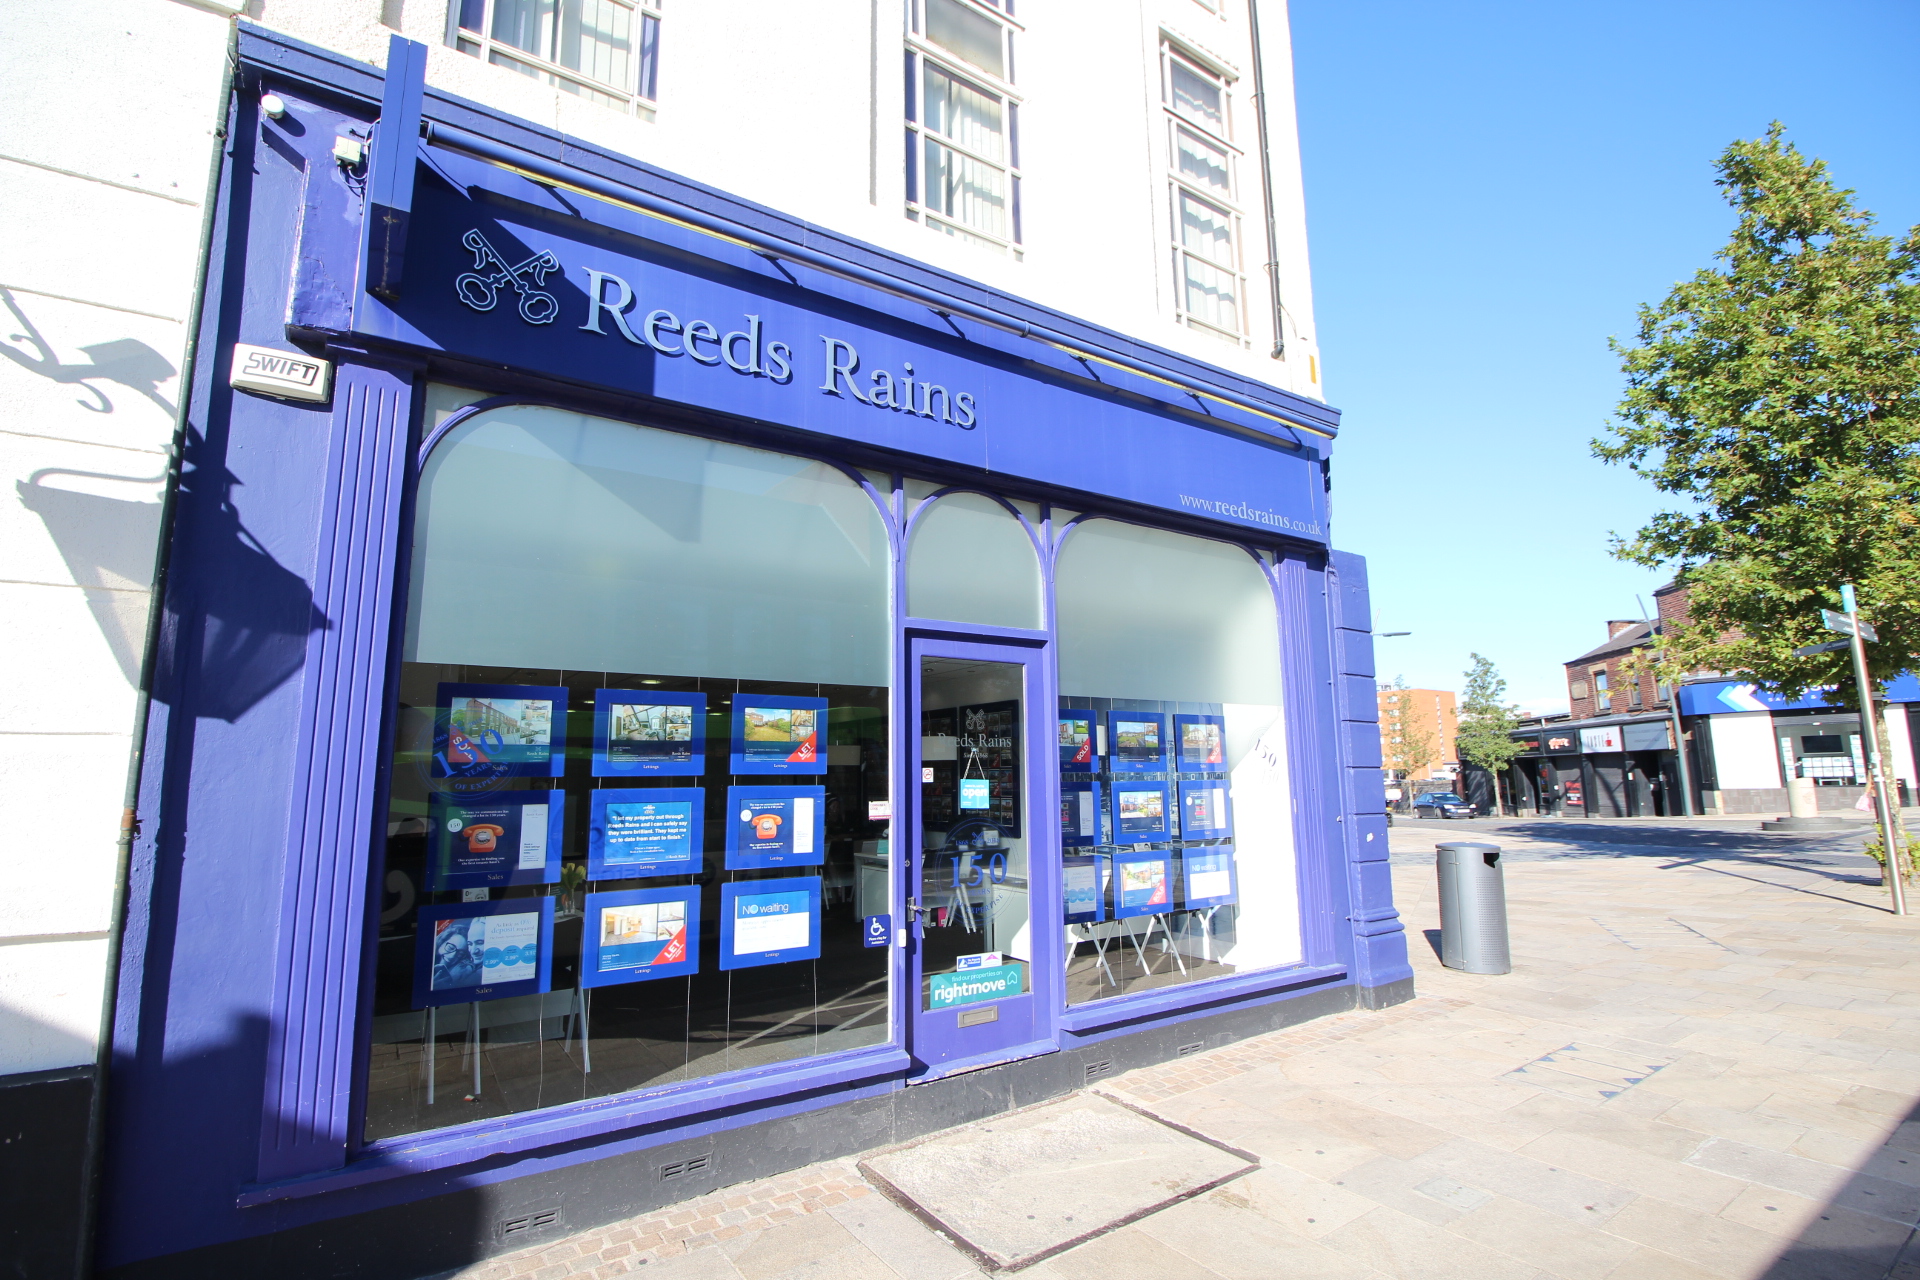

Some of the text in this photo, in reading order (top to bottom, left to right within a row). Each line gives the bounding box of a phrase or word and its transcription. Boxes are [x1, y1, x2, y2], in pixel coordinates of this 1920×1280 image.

[579, 266, 977, 429] Reeds Rains
[242, 351, 317, 382] SWIFT
[1179, 494, 1323, 536] www.reedsrains.co.uk
[979, 733, 1012, 748] Rains
[433, 729, 503, 778] 150
[797, 742, 812, 758] LET
[1076, 745, 1089, 761] SOLD
[464, 762, 494, 777] YEARS
[962, 788, 988, 799] open
[949, 852, 1008, 888] 150
[742, 903, 789, 915] NO waiting
[663, 939, 681, 959] LET
[951, 974, 961, 982] find
[970, 971, 996, 981] properties
[934, 979, 1006, 1003] rightmove
